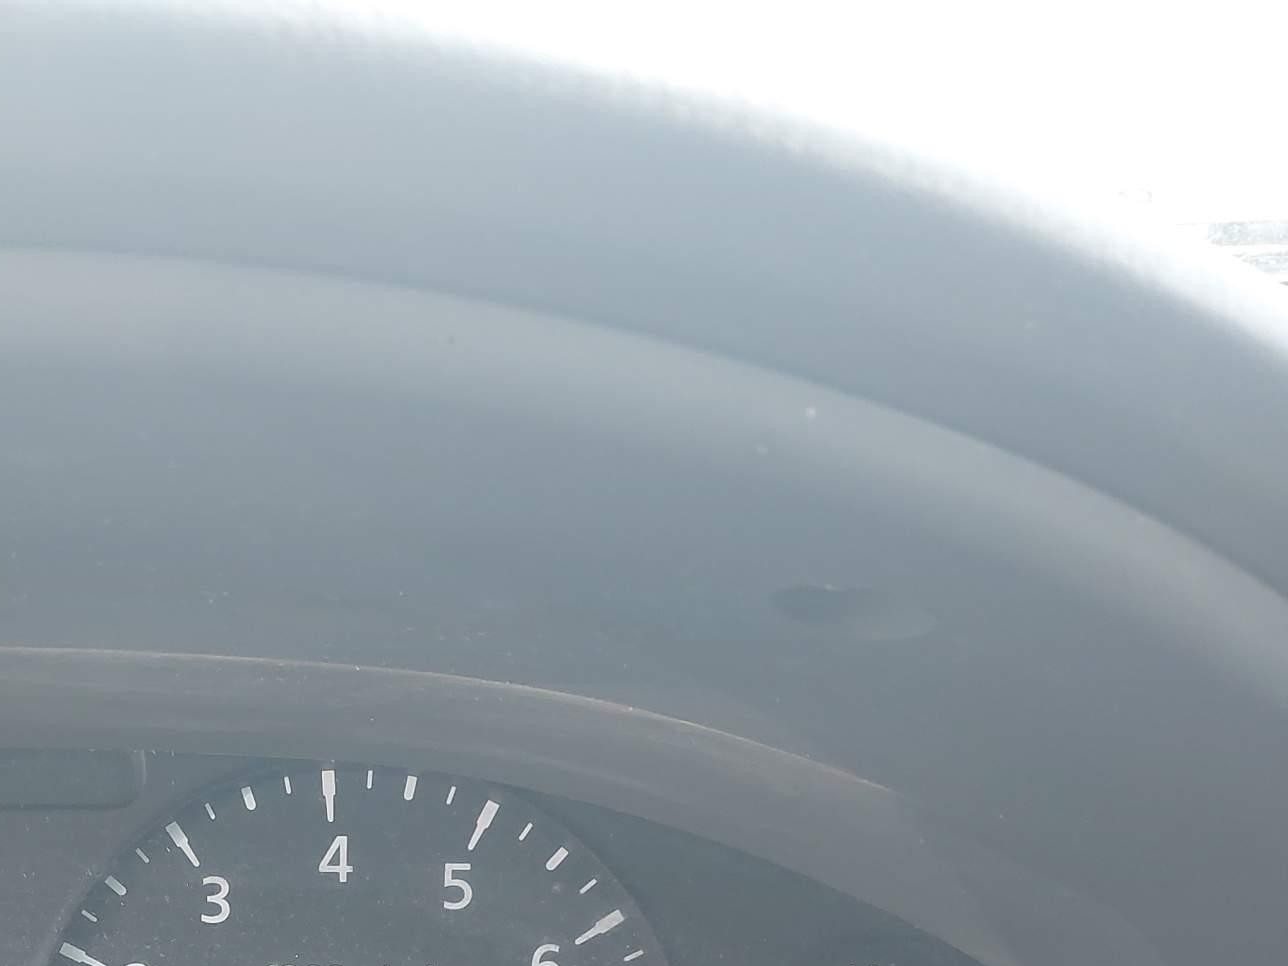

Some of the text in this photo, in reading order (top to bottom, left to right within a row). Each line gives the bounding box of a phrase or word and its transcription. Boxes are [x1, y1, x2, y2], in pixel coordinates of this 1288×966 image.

[318, 835, 354, 883] 4
[201, 876, 231, 924] 3
[443, 862, 473, 910] 5
